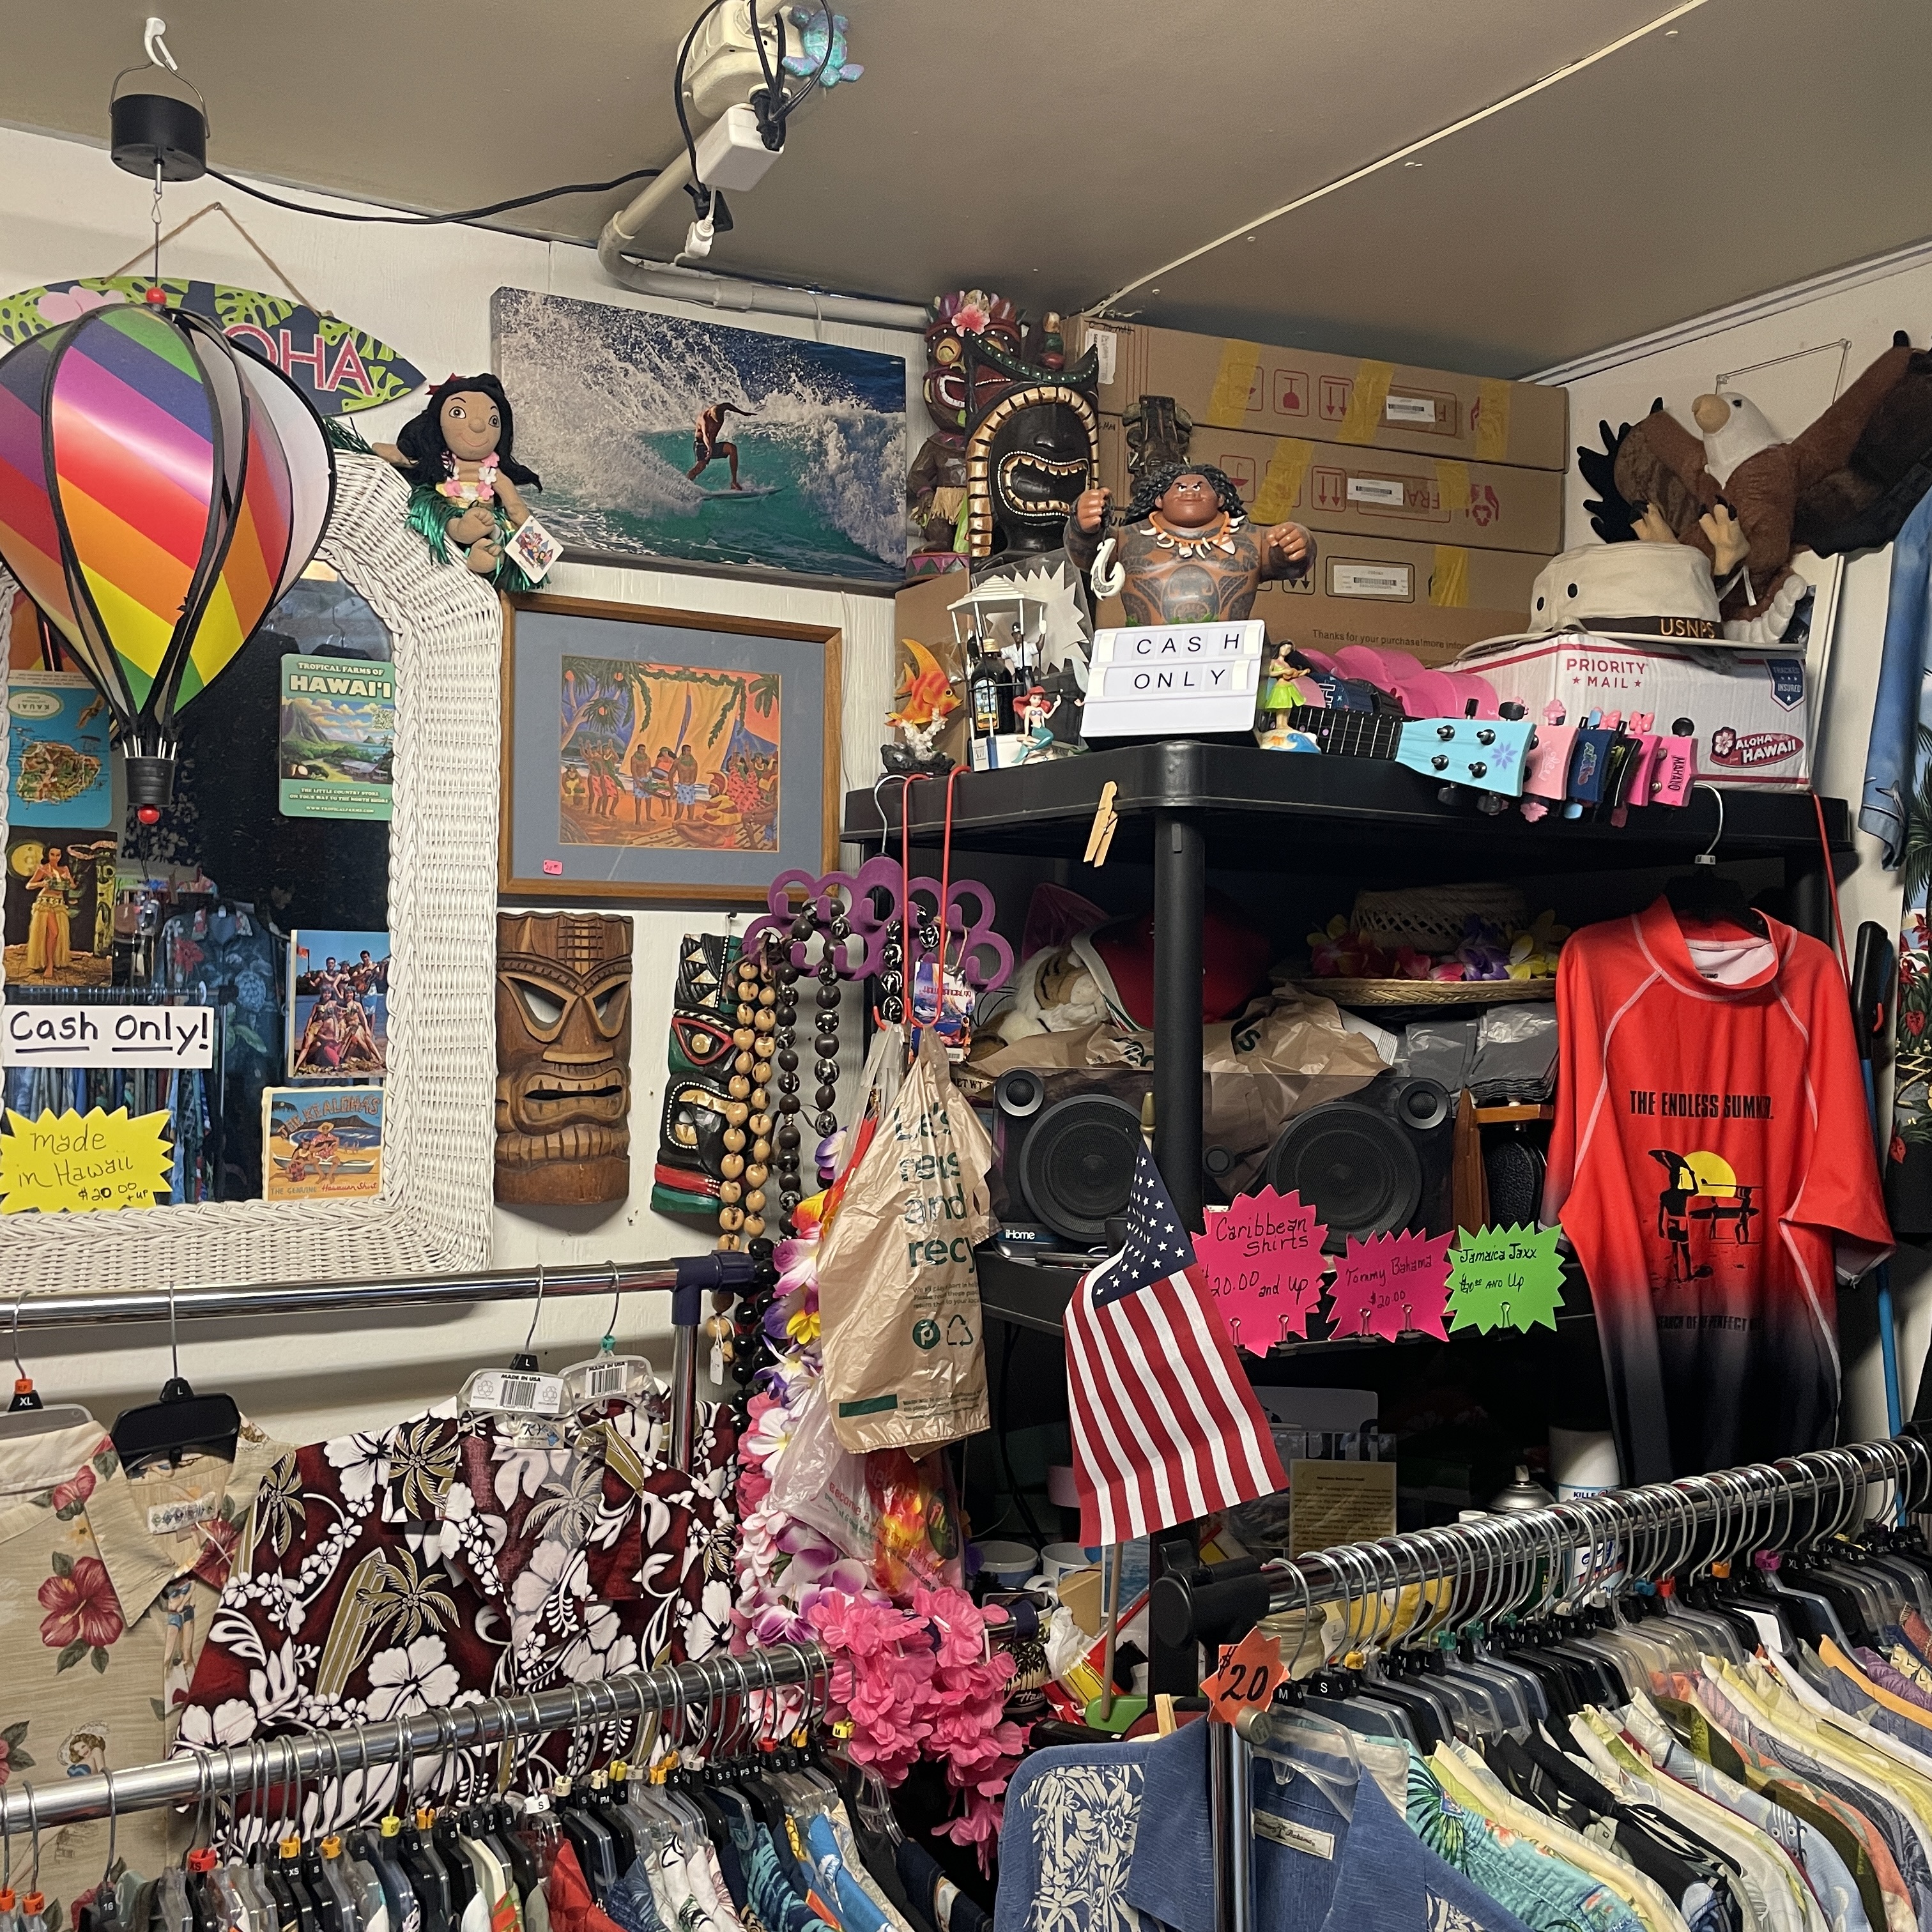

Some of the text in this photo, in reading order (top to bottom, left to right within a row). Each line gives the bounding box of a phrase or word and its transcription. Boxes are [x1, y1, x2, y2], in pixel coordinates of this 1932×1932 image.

[1661, 617, 1716, 639] USNPS
[1136, 631, 1239, 656] CASH
[1313, 629, 1344, 641] Thanks
[1346, 631, 1358, 642] for
[1360, 635, 1380, 645] your
[298, 661, 341, 673] TROPICAL
[342, 665, 371, 675] FARMS
[1567, 658, 1646, 675] PRIORITY
[289, 674, 392, 698] HAWAI'I
[1133, 667, 1226, 690] ONLY
[1588, 676, 1629, 689] MAIL
[1777, 683, 1802, 693] INSURED
[1736, 734, 1773, 750] ALOHA
[1742, 739, 1797, 763] HAWAII
[1667, 755, 1686, 792] MAHALO
[10, 1011, 209, 1055] Cash Only!
[1630, 1089, 1657, 1116] THE
[1661, 1091, 1719, 1118] ENDLESS
[904, 1183, 967, 1224] and
[1005, 1229, 1036, 1240] iHome
[1216, 1212, 1308, 1242] Caribbean
[1459, 1243, 1537, 1264] Jamaica Jaxx
[1345, 1254, 1432, 1287] Tommy Bahama
[1258, 1273, 1280, 1298] and
[1368, 1289, 1406, 1309] $20.00
[525, 1358, 530, 1367] L
[177, 1386, 183, 1395] L
[19, 1397, 33, 1406] XL
[1218, 1645, 1269, 1701] $20
[1278, 1689, 1288, 1700] M
[1320, 1682, 1328, 1693] S
[740, 1768, 750, 1776] PS
[538, 1801, 544, 1810] S
[581, 1796, 587, 1804] S
[600, 1795, 610, 1804] PM
[473, 1820, 479, 1828] S
[289, 1867, 300, 1876] XS
[314, 1865, 319, 1873] S
[103, 1902, 114, 1911] 16
